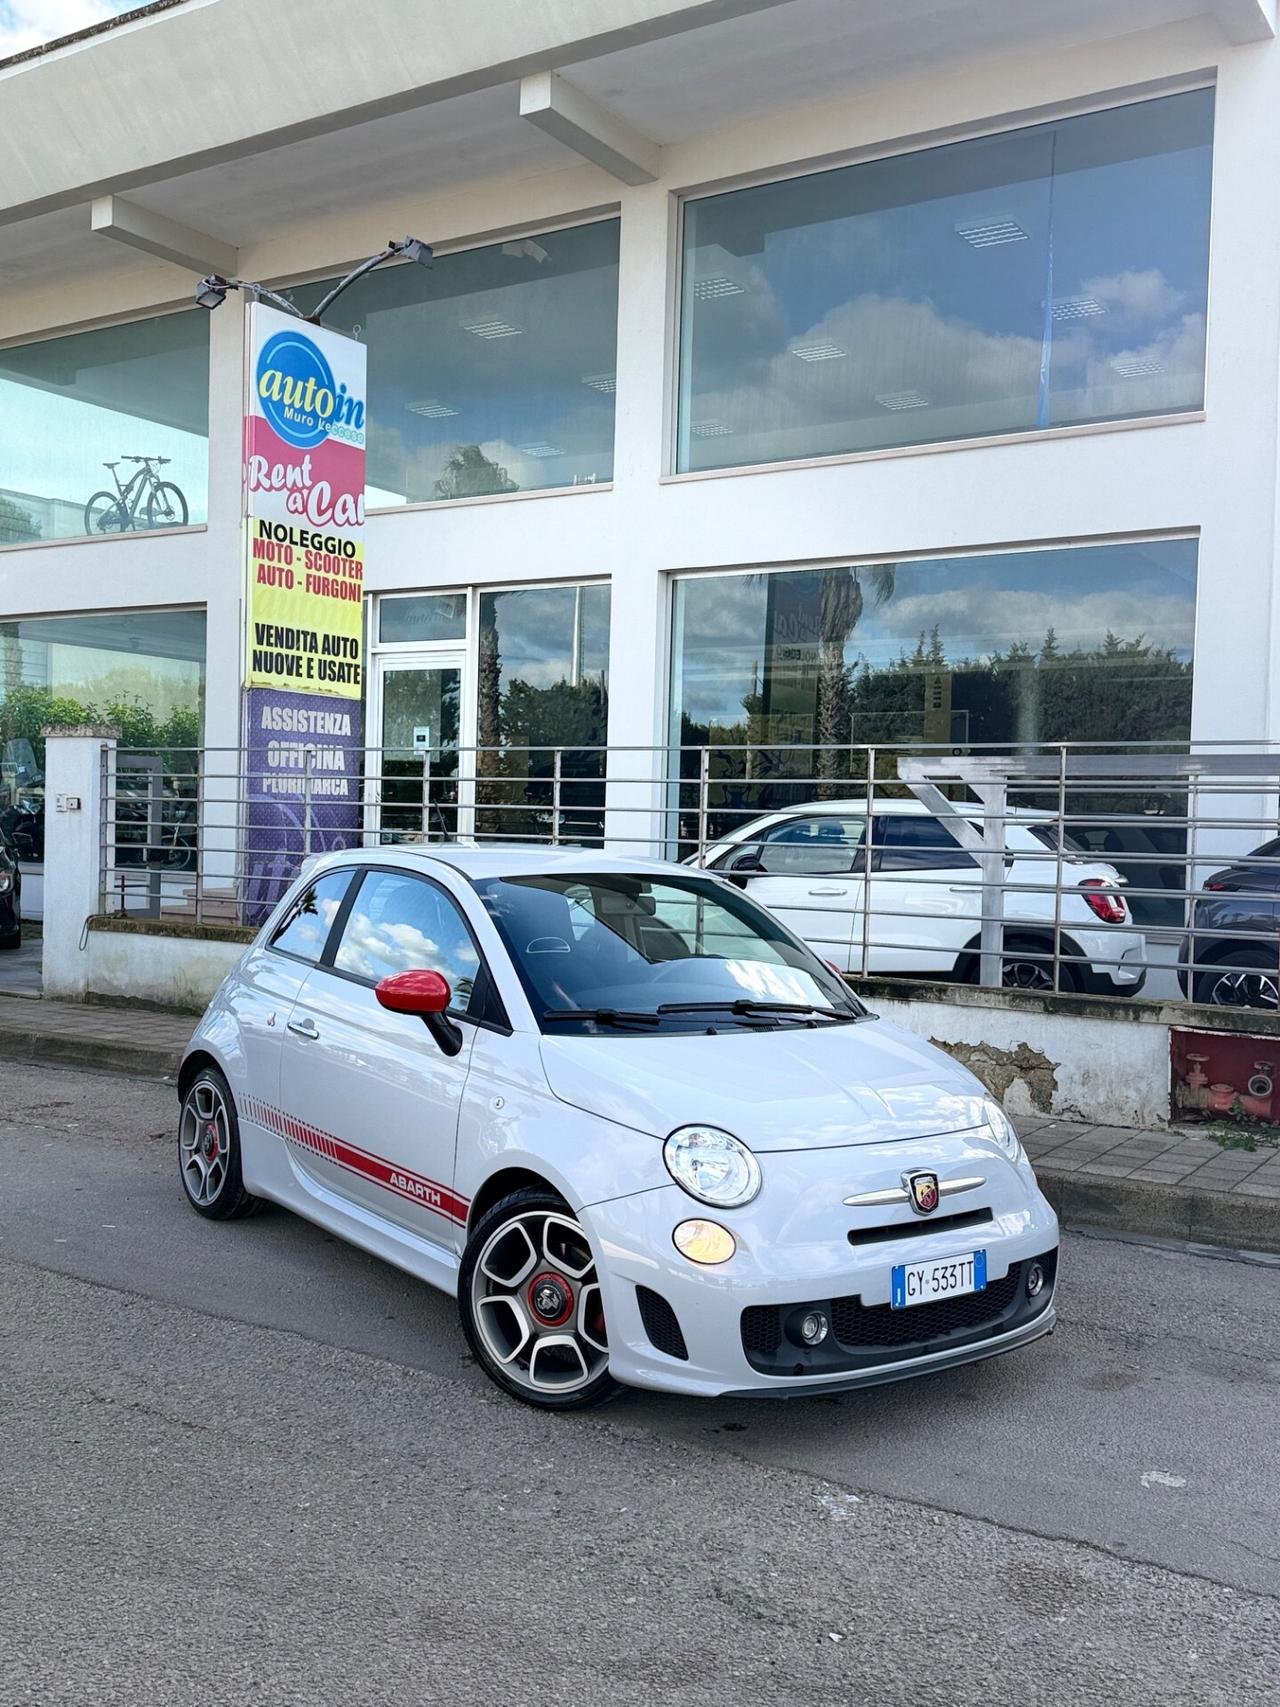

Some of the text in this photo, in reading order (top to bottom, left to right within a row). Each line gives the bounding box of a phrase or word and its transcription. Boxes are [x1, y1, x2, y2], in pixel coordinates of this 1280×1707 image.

[283, 407, 314, 427] Muro
[249, 454, 313, 492] Rent
[286, 489, 306, 514] a
[259, 519, 356, 558] NOLEGGIO
[253, 538, 293, 566] MOTO
[304, 549, 363, 580] SCOOTER
[257, 563, 294, 590] AUTO
[305, 573, 361, 602] FURGONI
[255, 622, 359, 660] VENDITA AUTO
[252, 649, 361, 685] NUOVE E USATE
[261, 706, 351, 736] ASSISTENZA
[267, 740, 345, 771] OFFICINA
[390, 1172, 441, 1206] ABARTH
[932, 1260, 974, 1293] 533TT
